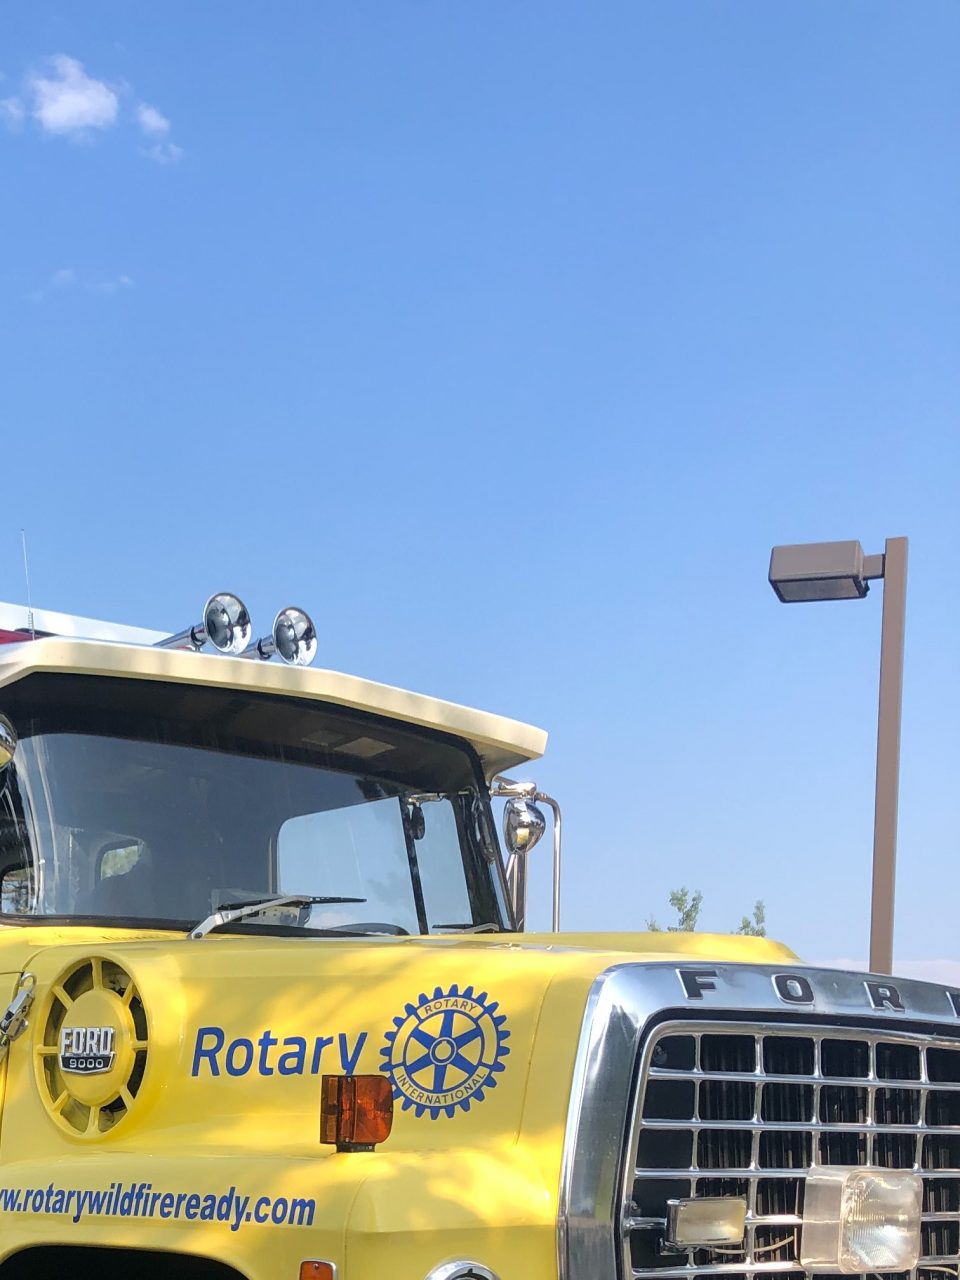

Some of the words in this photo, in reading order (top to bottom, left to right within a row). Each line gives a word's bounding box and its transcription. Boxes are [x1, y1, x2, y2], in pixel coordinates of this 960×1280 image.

[424, 998, 478, 1015] ROTARY
[675, 968, 960, 1018] FOR
[60, 1027, 113, 1057] FORD
[191, 1026, 369, 1077] Rotary
[69, 1058, 104, 1069] 9000
[396, 1071, 487, 1105] INTERNATIONAL
